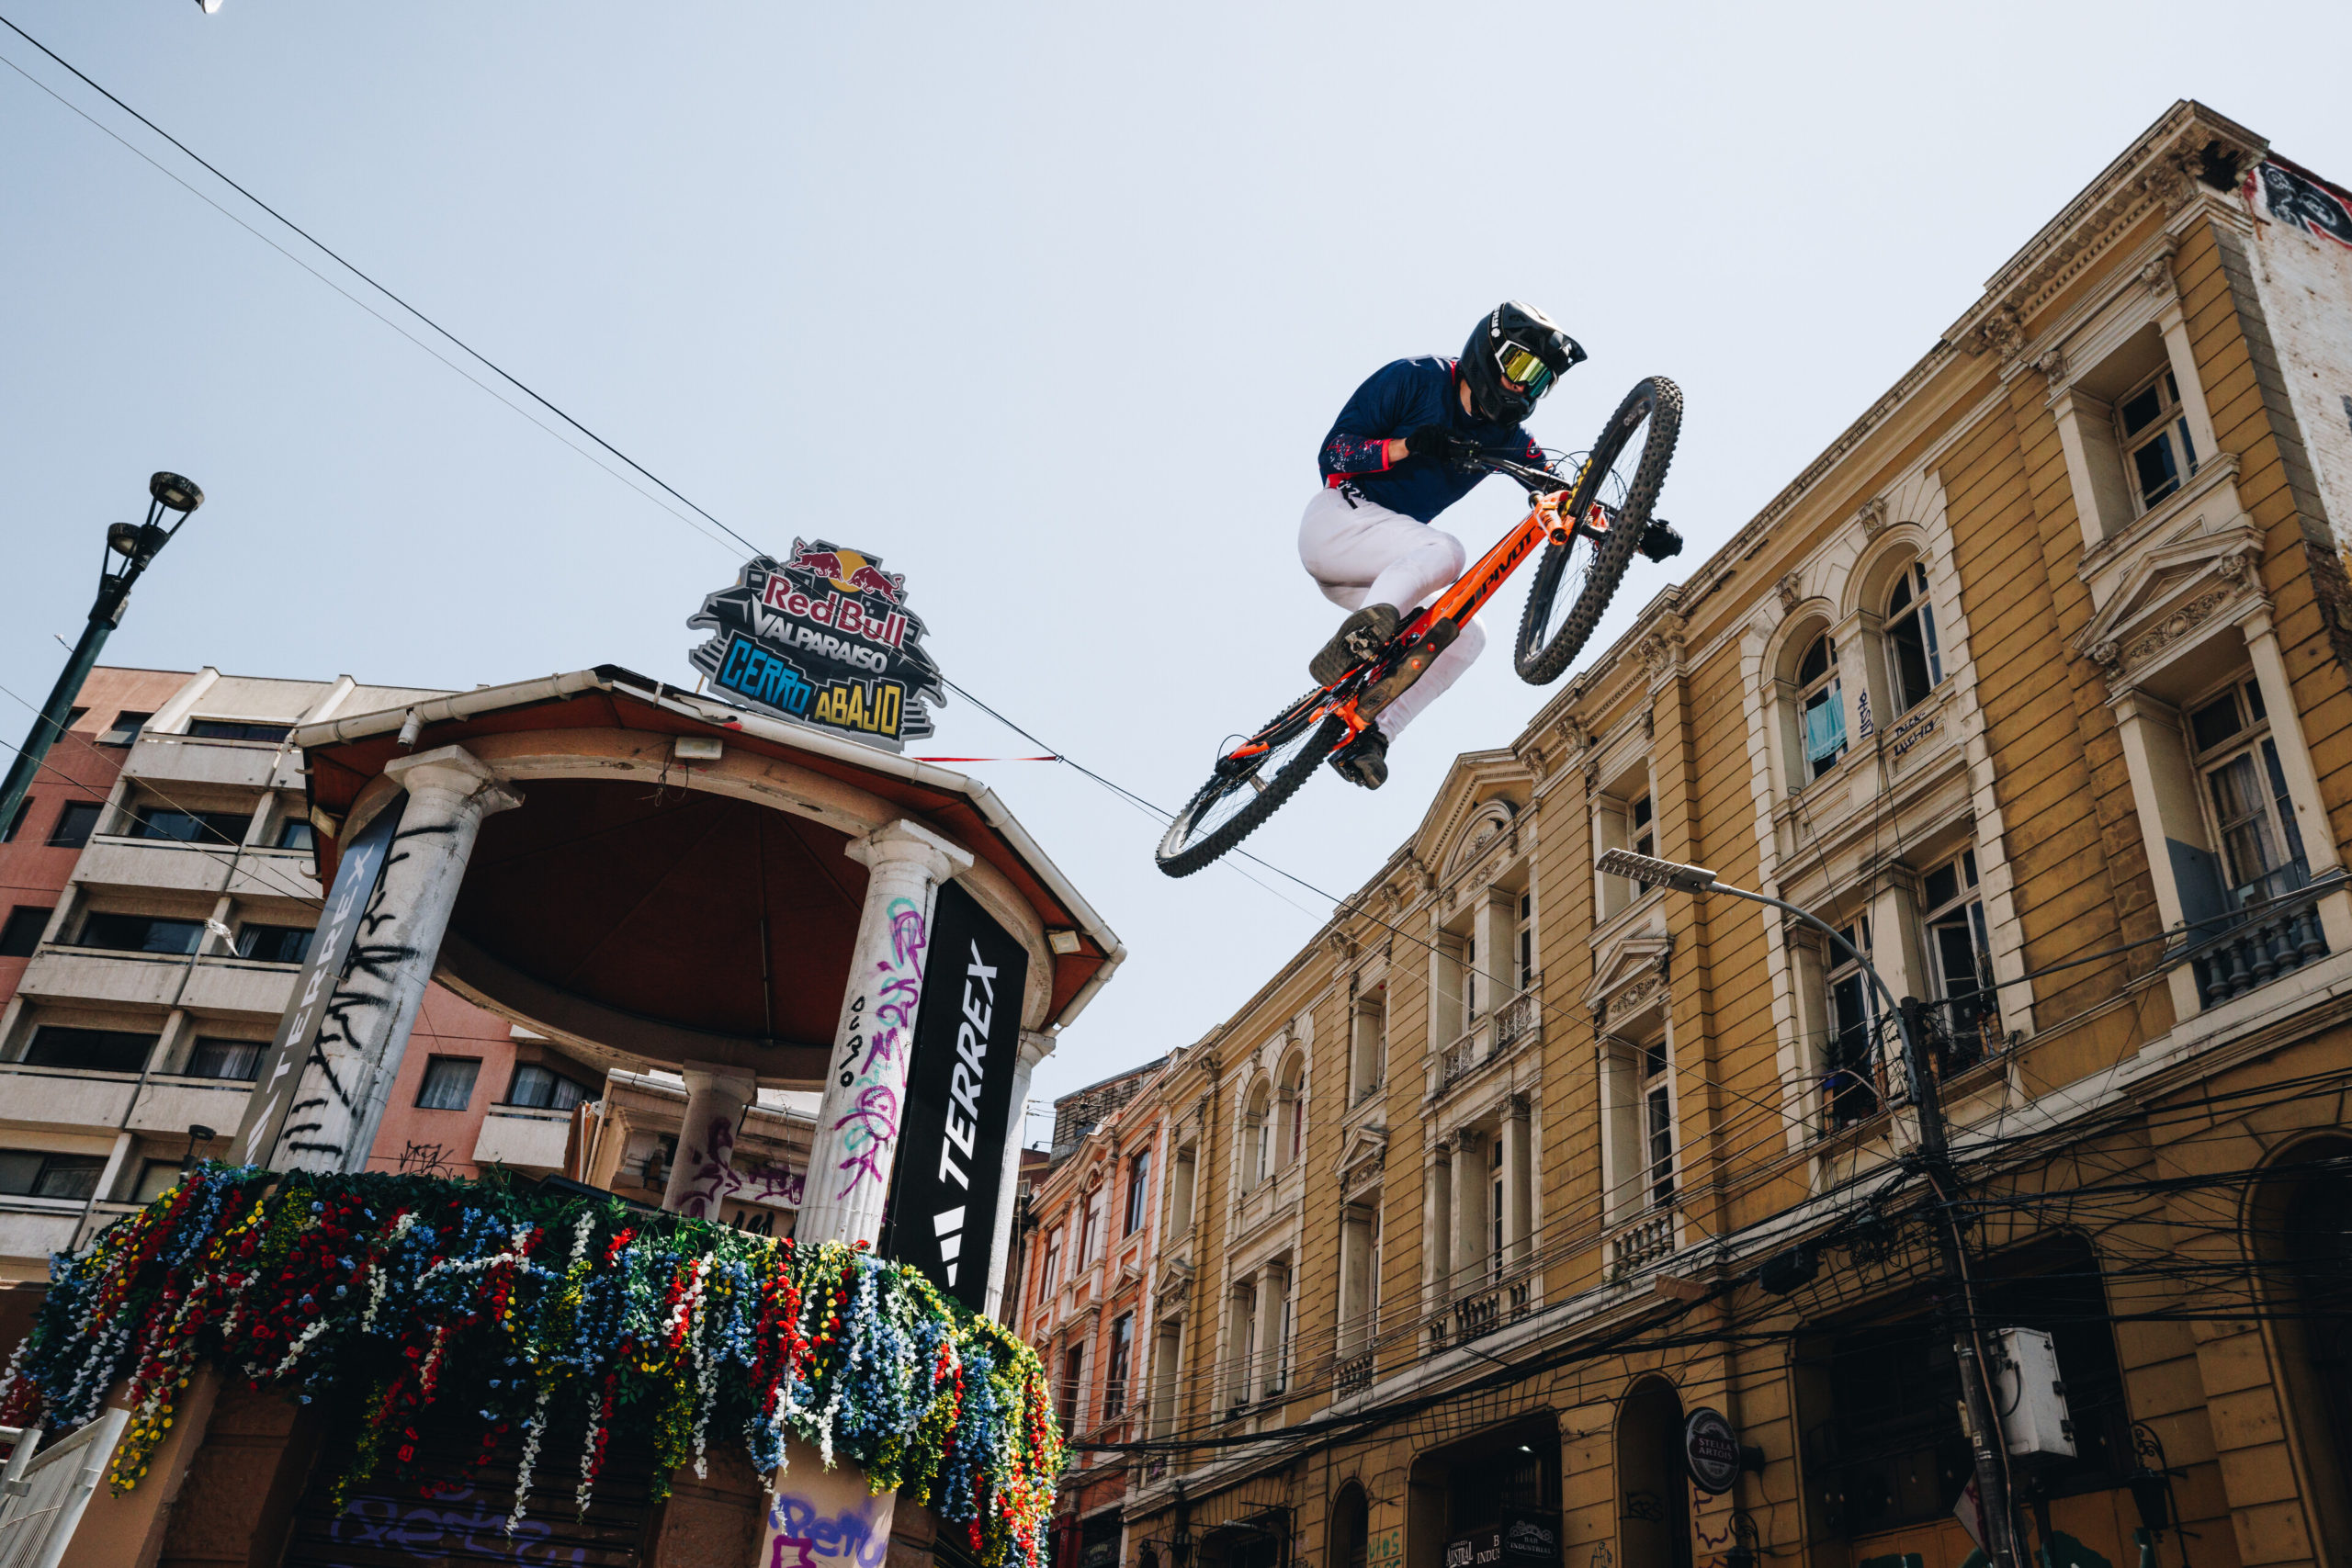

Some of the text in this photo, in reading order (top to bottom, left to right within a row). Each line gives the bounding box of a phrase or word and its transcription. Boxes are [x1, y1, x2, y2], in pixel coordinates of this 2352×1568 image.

[1482, 525, 1536, 594] PIVOT
[750, 592, 888, 674] VALPARAISO
[762, 572, 908, 648] Red Bull
[720, 637, 901, 736] CERRO ABAJO
[267, 842, 375, 1093] TERREX
[938, 937, 999, 1192] TERREX
[1699, 1438, 1732, 1451] STELLA
[1699, 1446, 1733, 1461] ARTOIS
[1445, 1540, 1474, 1566] AUSTRAL
[1510, 1542, 1552, 1554] INDUSTRIAL
[1524, 1536, 1539, 1545] BAR
